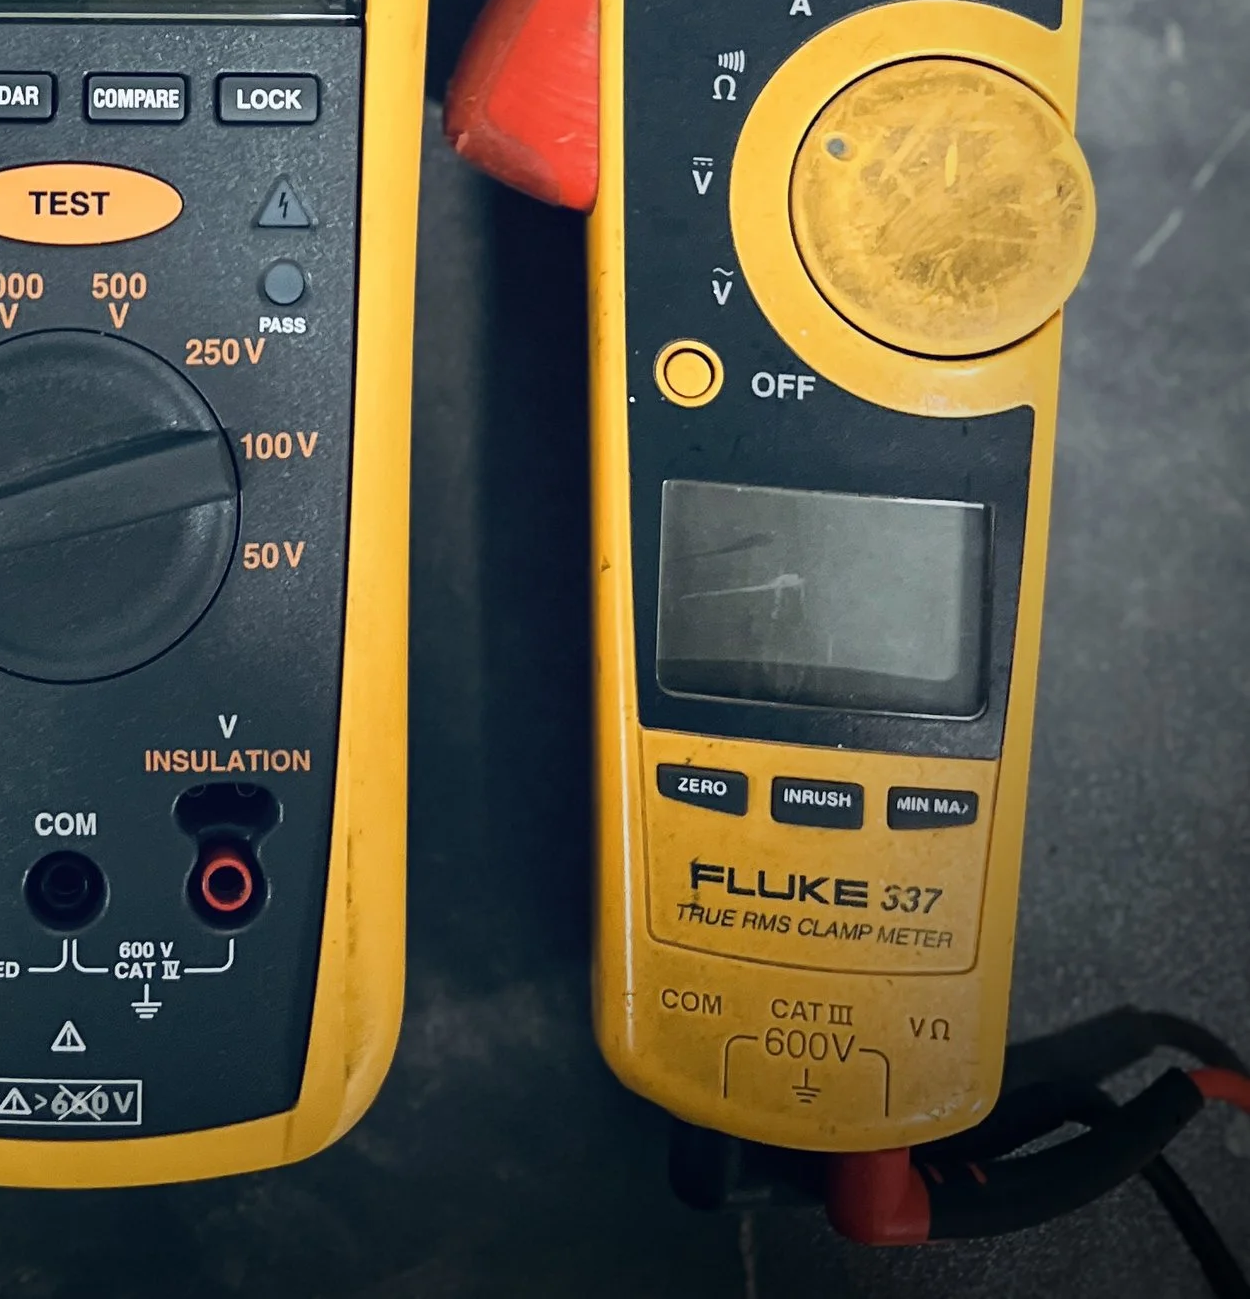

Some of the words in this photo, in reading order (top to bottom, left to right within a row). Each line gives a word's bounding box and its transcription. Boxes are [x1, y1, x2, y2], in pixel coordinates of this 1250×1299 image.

[93, 88, 179, 109] COMPARE
[236, 88, 302, 110] LOCK
[29, 191, 110, 216] TEST
[92, 273, 146, 299] 500
[109, 302, 130, 329] V
[259, 317, 306, 334] PASS
[751, 372, 816, 400] OFF
[218, 715, 237, 739] V
[145, 749, 310, 772] INSULATION
[677, 777, 727, 797] ZERO
[783, 788, 851, 808] INRUSH
[896, 796, 929, 813] MIN
[34, 813, 97, 837] COM
[690, 859, 868, 909] FLUKE
[880, 884, 943, 915] 337
[677, 903, 737, 928] TRUE
[742, 912, 791, 933] RMS
[797, 918, 873, 943] CLAMP
[877, 928, 953, 949] METER
[114, 962, 156, 980] CAT
[161, 960, 181, 980] IV
[661, 988, 722, 1016] COM
[771, 999, 821, 1021] CAT
[828, 1003, 853, 1026] III
[765, 1027, 855, 1063] 600V
